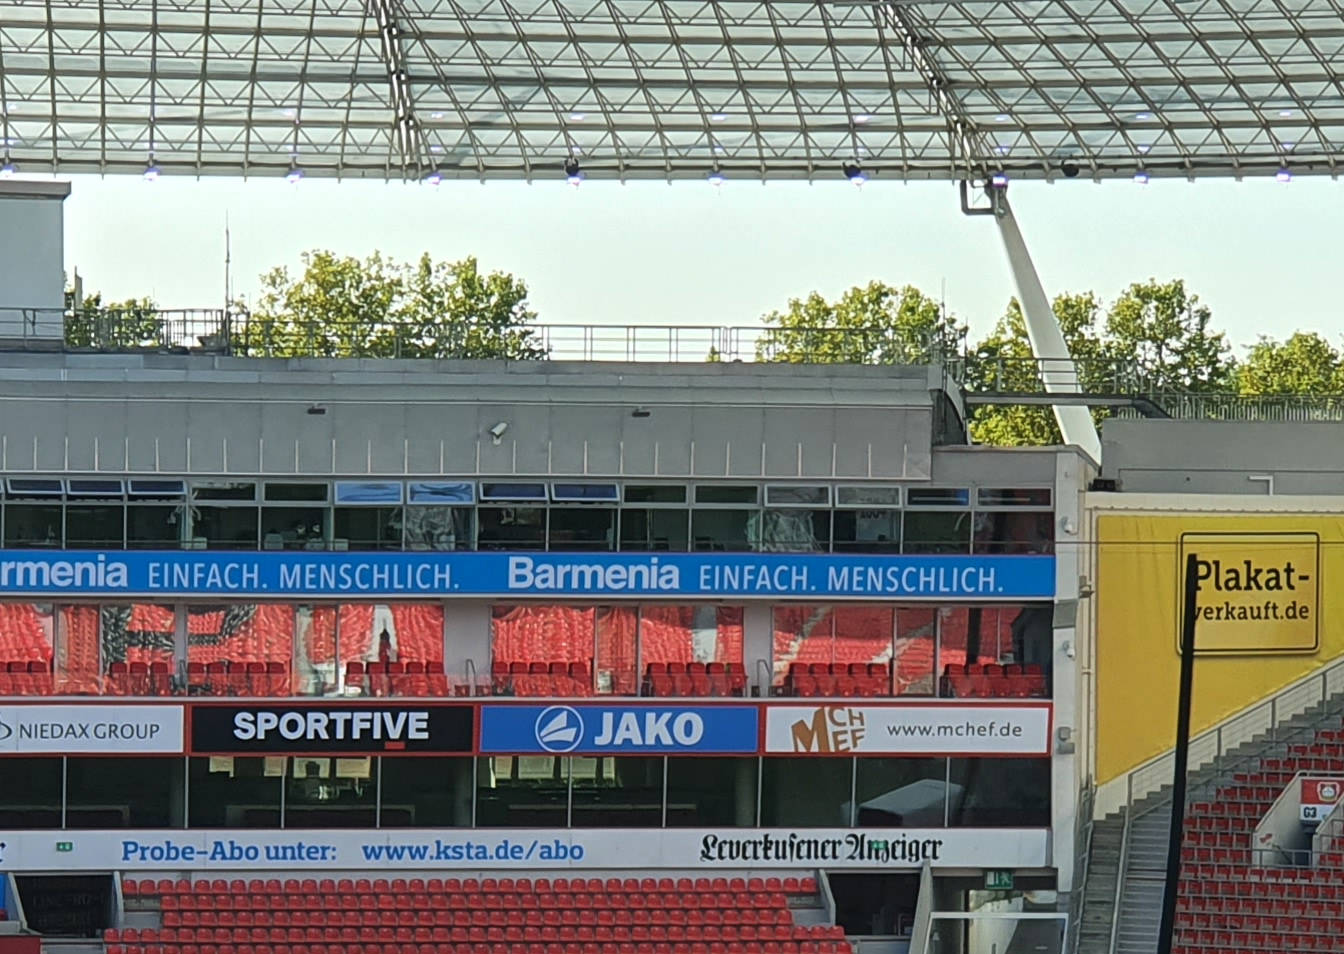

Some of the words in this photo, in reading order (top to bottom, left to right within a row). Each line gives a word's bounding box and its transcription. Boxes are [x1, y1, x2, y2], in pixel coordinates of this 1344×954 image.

[148, 562, 267, 589] EINFACH.
[280, 562, 459, 590] MENSCHLICH.
[508, 556, 680, 590] Barmenia
[699, 565, 816, 591] EINFACH.
[828, 565, 1004, 593] MENSCHLICH.
[1196, 560, 1310, 591] Plakat-
[20, 722, 89, 739] NIEDAX
[92, 722, 160, 740] GROUP
[233, 711, 429, 741] SPORTFIVE
[594, 712, 704, 745] JAKO
[887, 721, 1023, 737] www.mchef.de
[122, 840, 260, 861] Probe-Abo
[265, 842, 337, 861] unter:
[362, 839, 584, 863] www.ksta.de/abo
